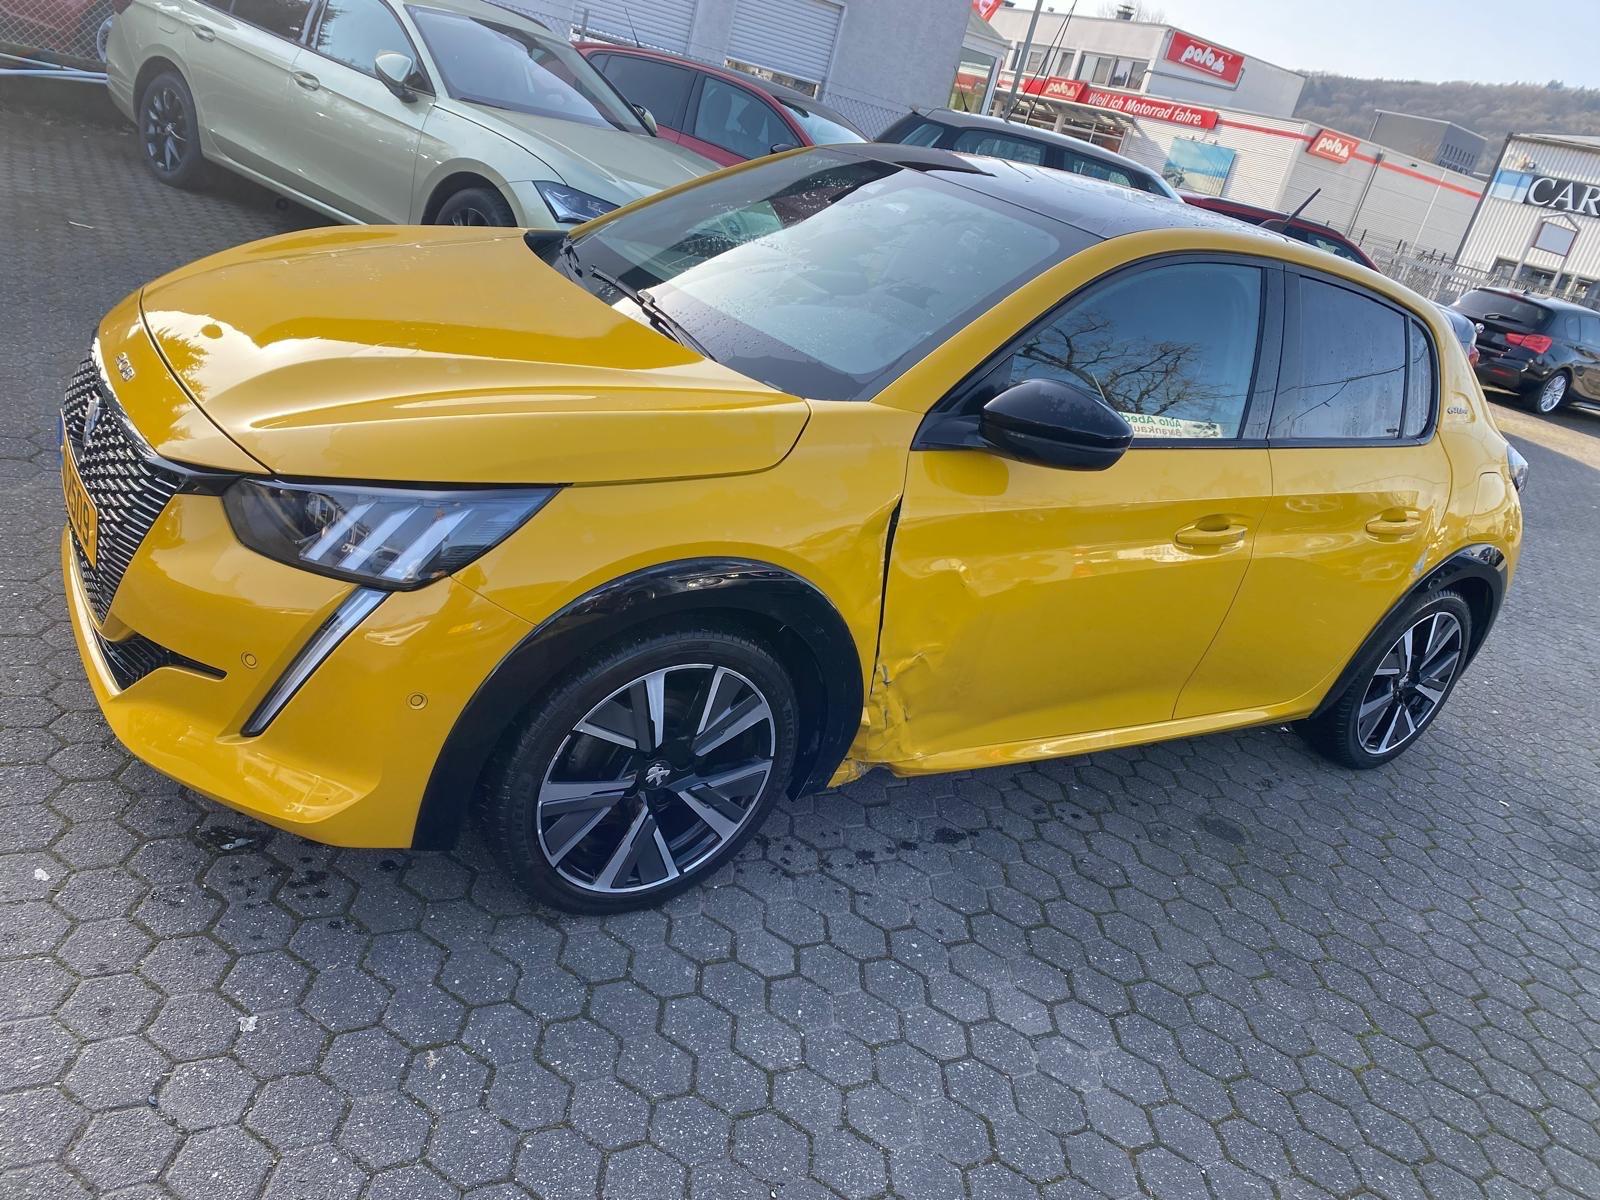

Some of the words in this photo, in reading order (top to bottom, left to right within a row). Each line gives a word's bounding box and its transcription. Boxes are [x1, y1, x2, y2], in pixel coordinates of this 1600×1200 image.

[1180, 45, 1215, 66] polo
[1046, 82, 1069, 96] polo
[1087, 92, 1108, 107] Weil
[1108, 95, 1124, 110] ich
[1124, 99, 1173, 119] Motorrad
[1173, 108, 1202, 125] fahre.
[1316, 136, 1343, 153] polo
[1527, 177, 1600, 216] CAR
